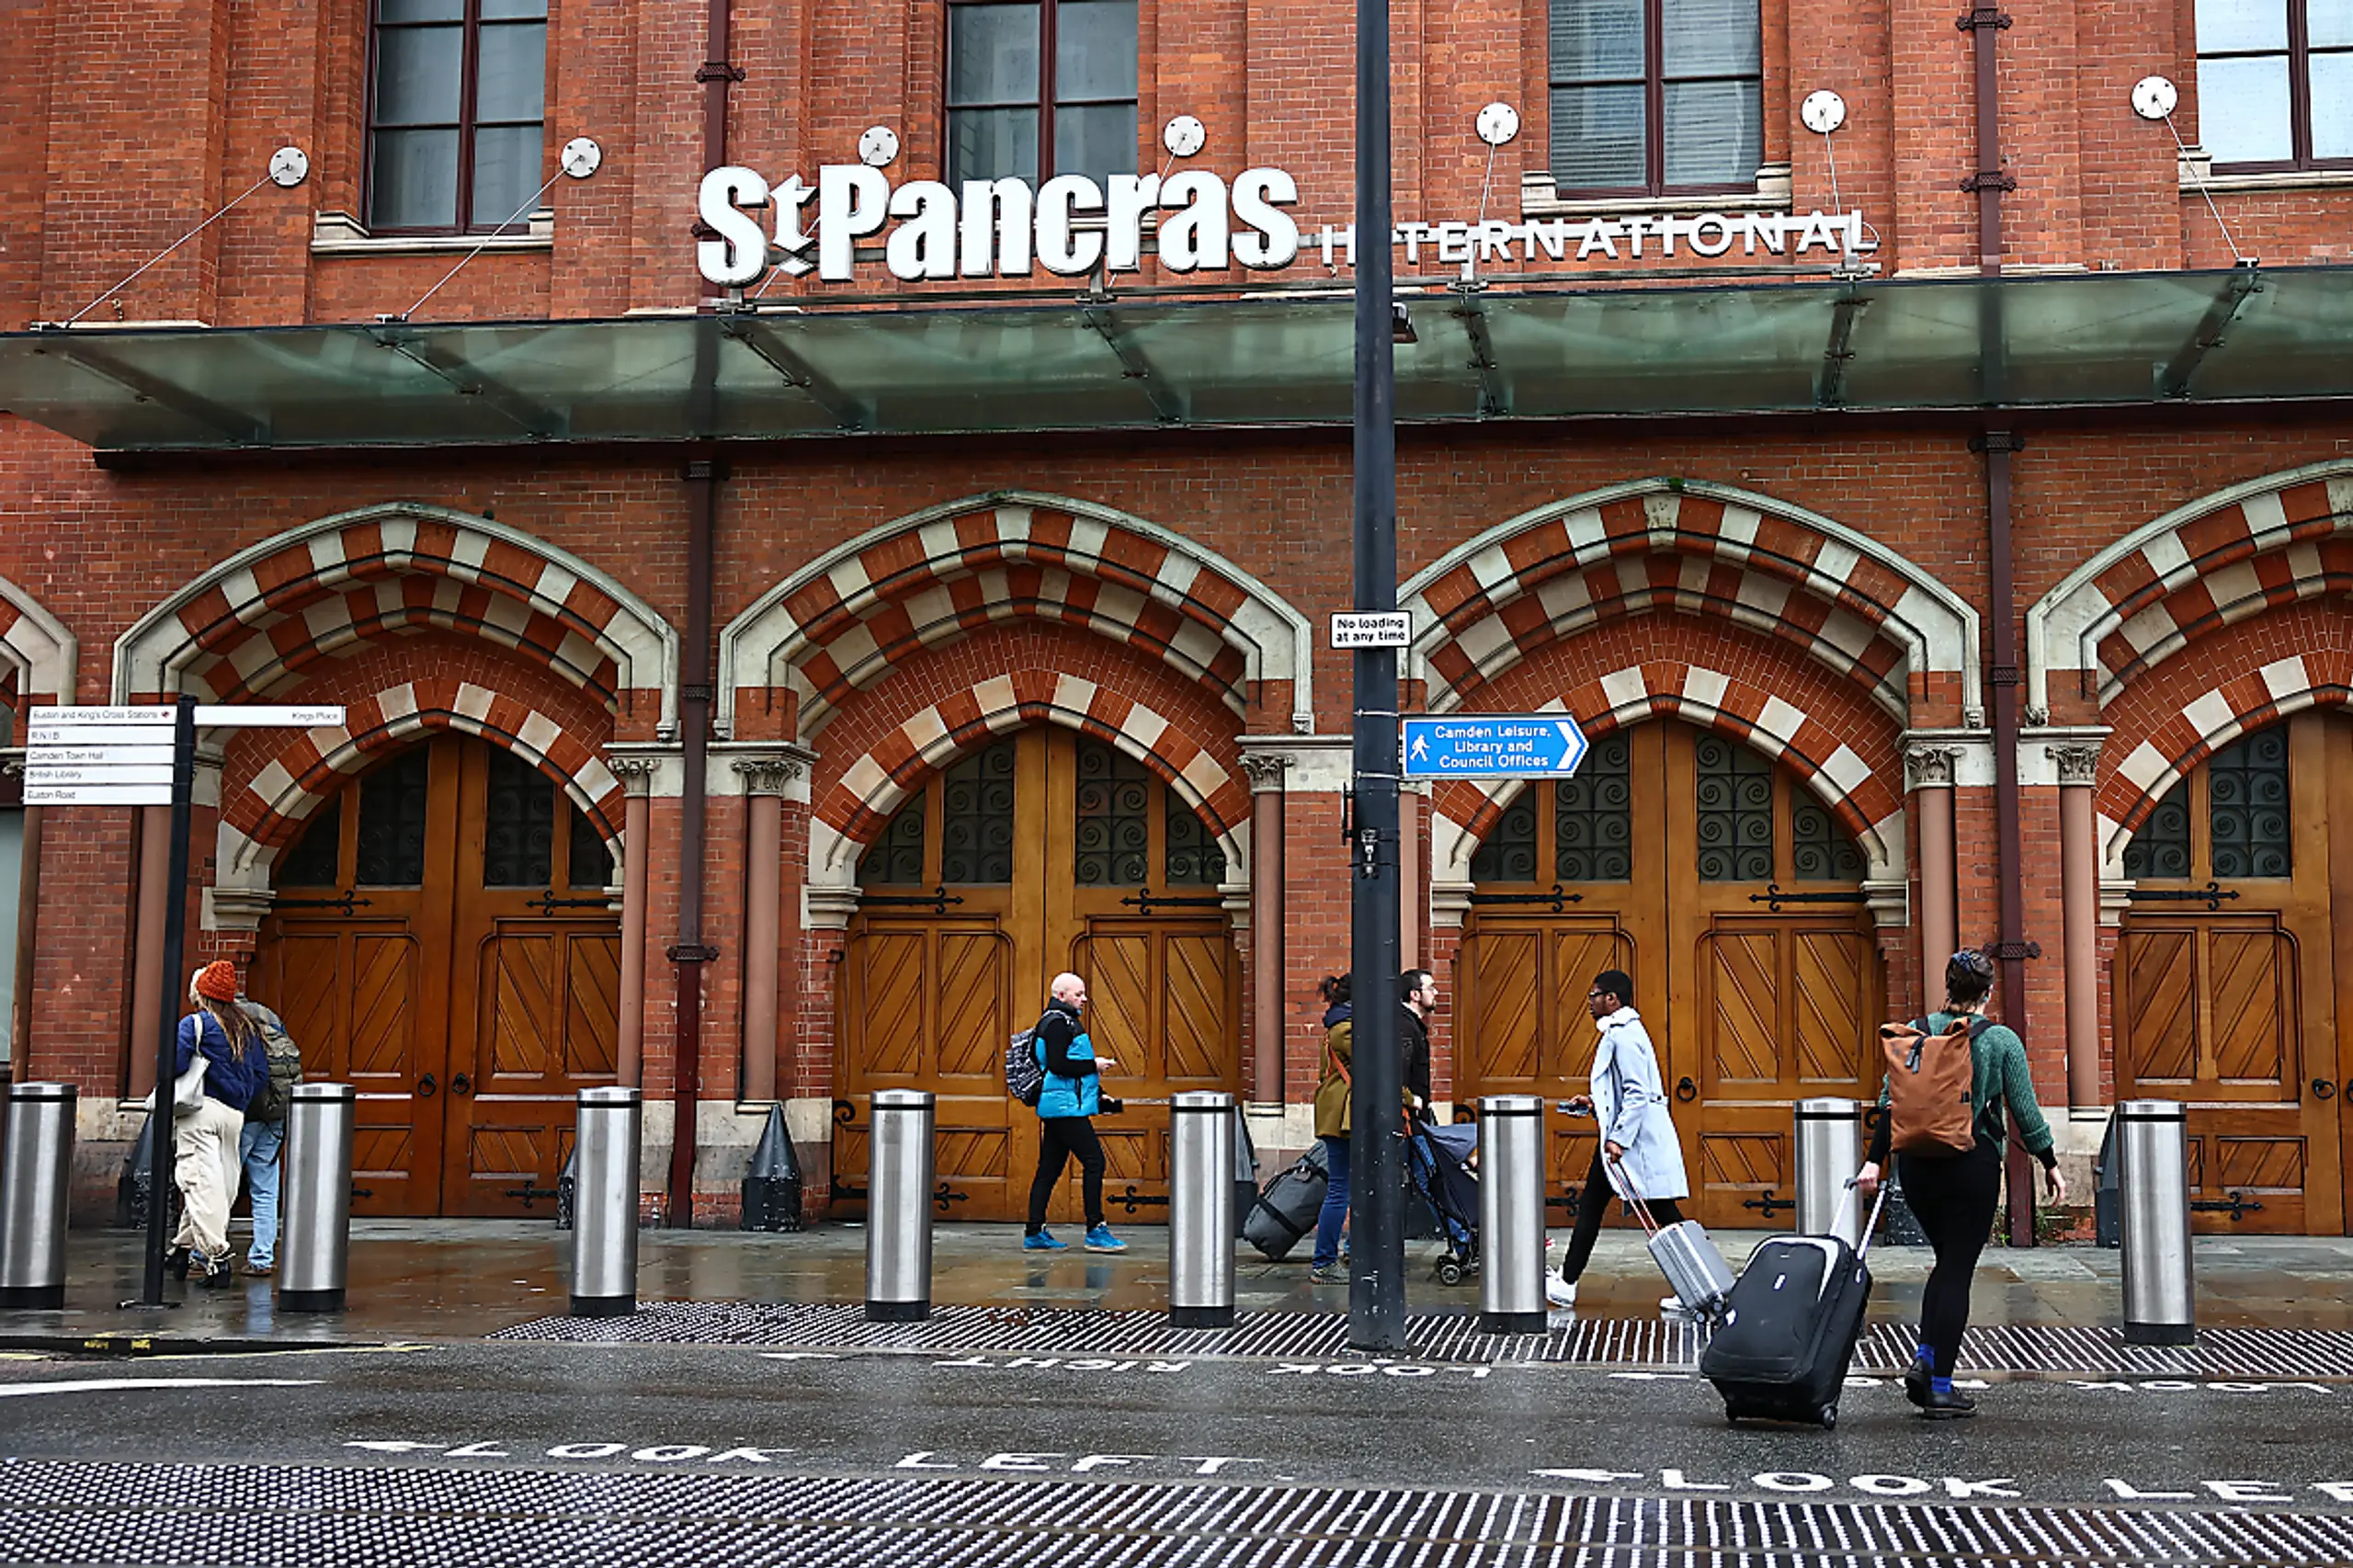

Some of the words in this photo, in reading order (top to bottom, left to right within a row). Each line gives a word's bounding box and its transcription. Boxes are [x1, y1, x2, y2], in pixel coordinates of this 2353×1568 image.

[1322, 210, 1878, 267] ITERNATIONAL
[1337, 619, 1356, 629] No
[1358, 618, 1404, 629] loading
[1336, 632, 1348, 642] at
[1353, 632, 1374, 642] any
[1379, 630, 1405, 641] time
[33, 710, 60, 719] Euston
[61, 710, 75, 719] and
[77, 710, 101, 721] King's
[102, 710, 125, 719] Cross
[128, 710, 158, 719] Stations
[1435, 725, 1492, 738] Camden
[1455, 740, 1503, 754] Library
[1507, 739, 1533, 753] and
[29, 751, 64, 760] Camden
[65, 751, 87, 760] Town
[88, 751, 103, 760] Hall
[1439, 756, 1494, 768] Council
[1498, 755, 1549, 767] Offices
[28, 770, 54, 779] British
[55, 770, 83, 779] Library
[28, 790, 54, 800] Euston
[55, 790, 76, 800] Road
[1267, 1363, 1493, 1378] LOOK
[443, 1441, 794, 1462] LOOK
[889, 1451, 1265, 1474] LEFT
[1662, 1470, 2022, 1498] LOOK
